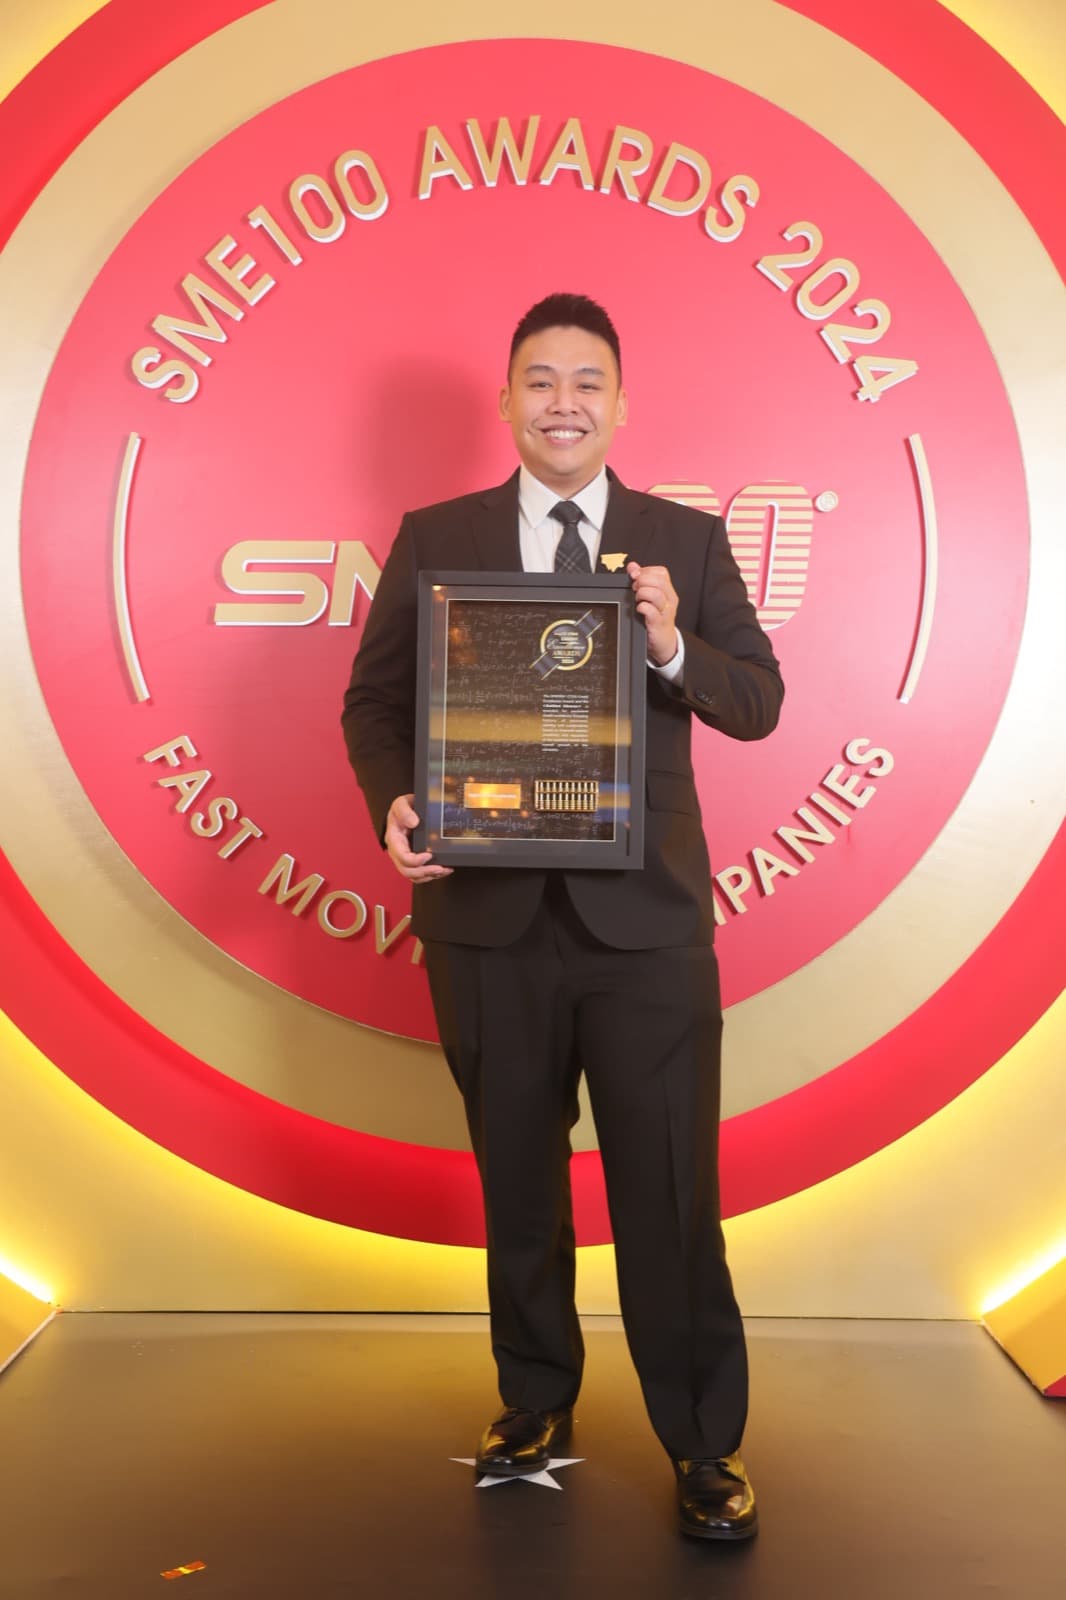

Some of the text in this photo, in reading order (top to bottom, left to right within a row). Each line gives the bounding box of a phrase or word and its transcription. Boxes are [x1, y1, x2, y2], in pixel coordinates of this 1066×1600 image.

[131, 115, 919, 403] SME100 AWARDS 2024
[143, 735, 895, 965] FAST MOV PANIES
